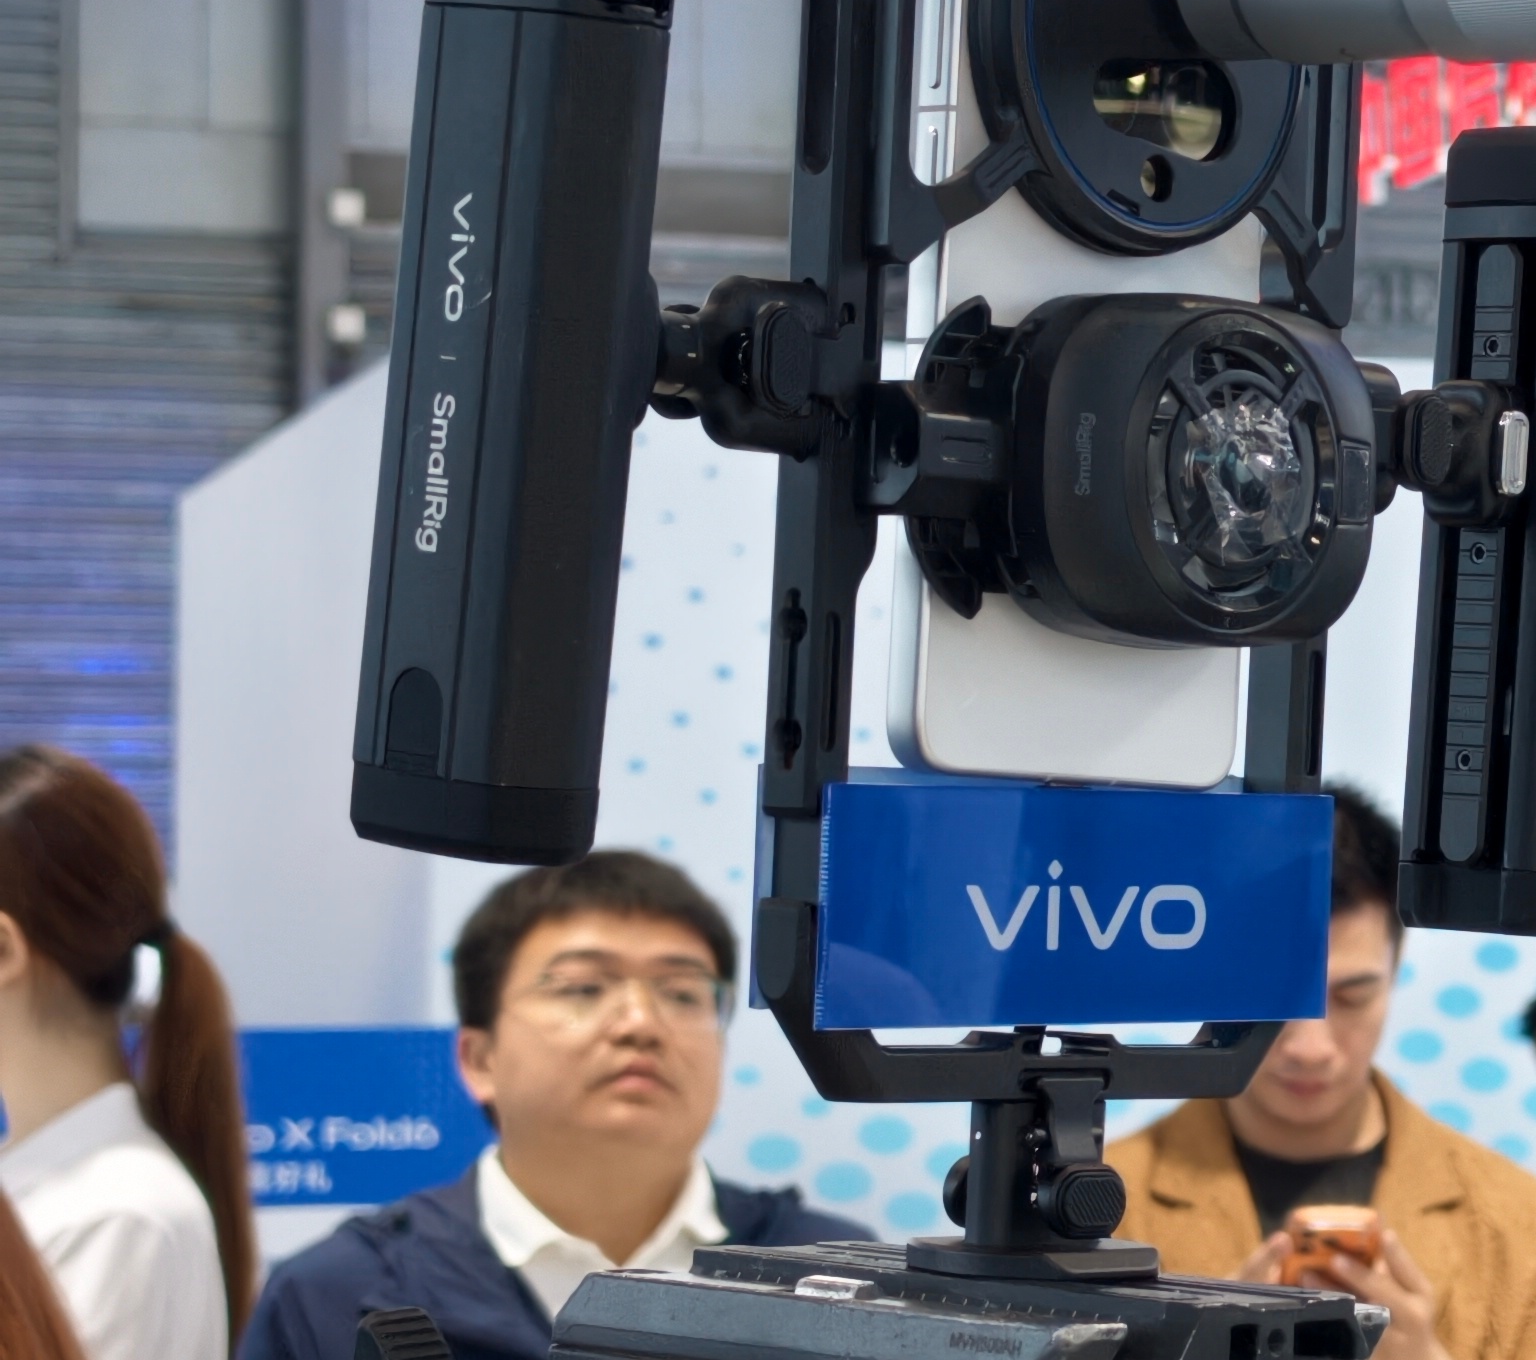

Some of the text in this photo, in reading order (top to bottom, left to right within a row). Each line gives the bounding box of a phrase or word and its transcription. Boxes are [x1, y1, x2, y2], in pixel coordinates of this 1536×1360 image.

[415, 192, 476, 553] vivo SmallRig
[965, 859, 1207, 951] vivo
[279, 1116, 315, 1153] X
[320, 1114, 441, 1153] Fold6
